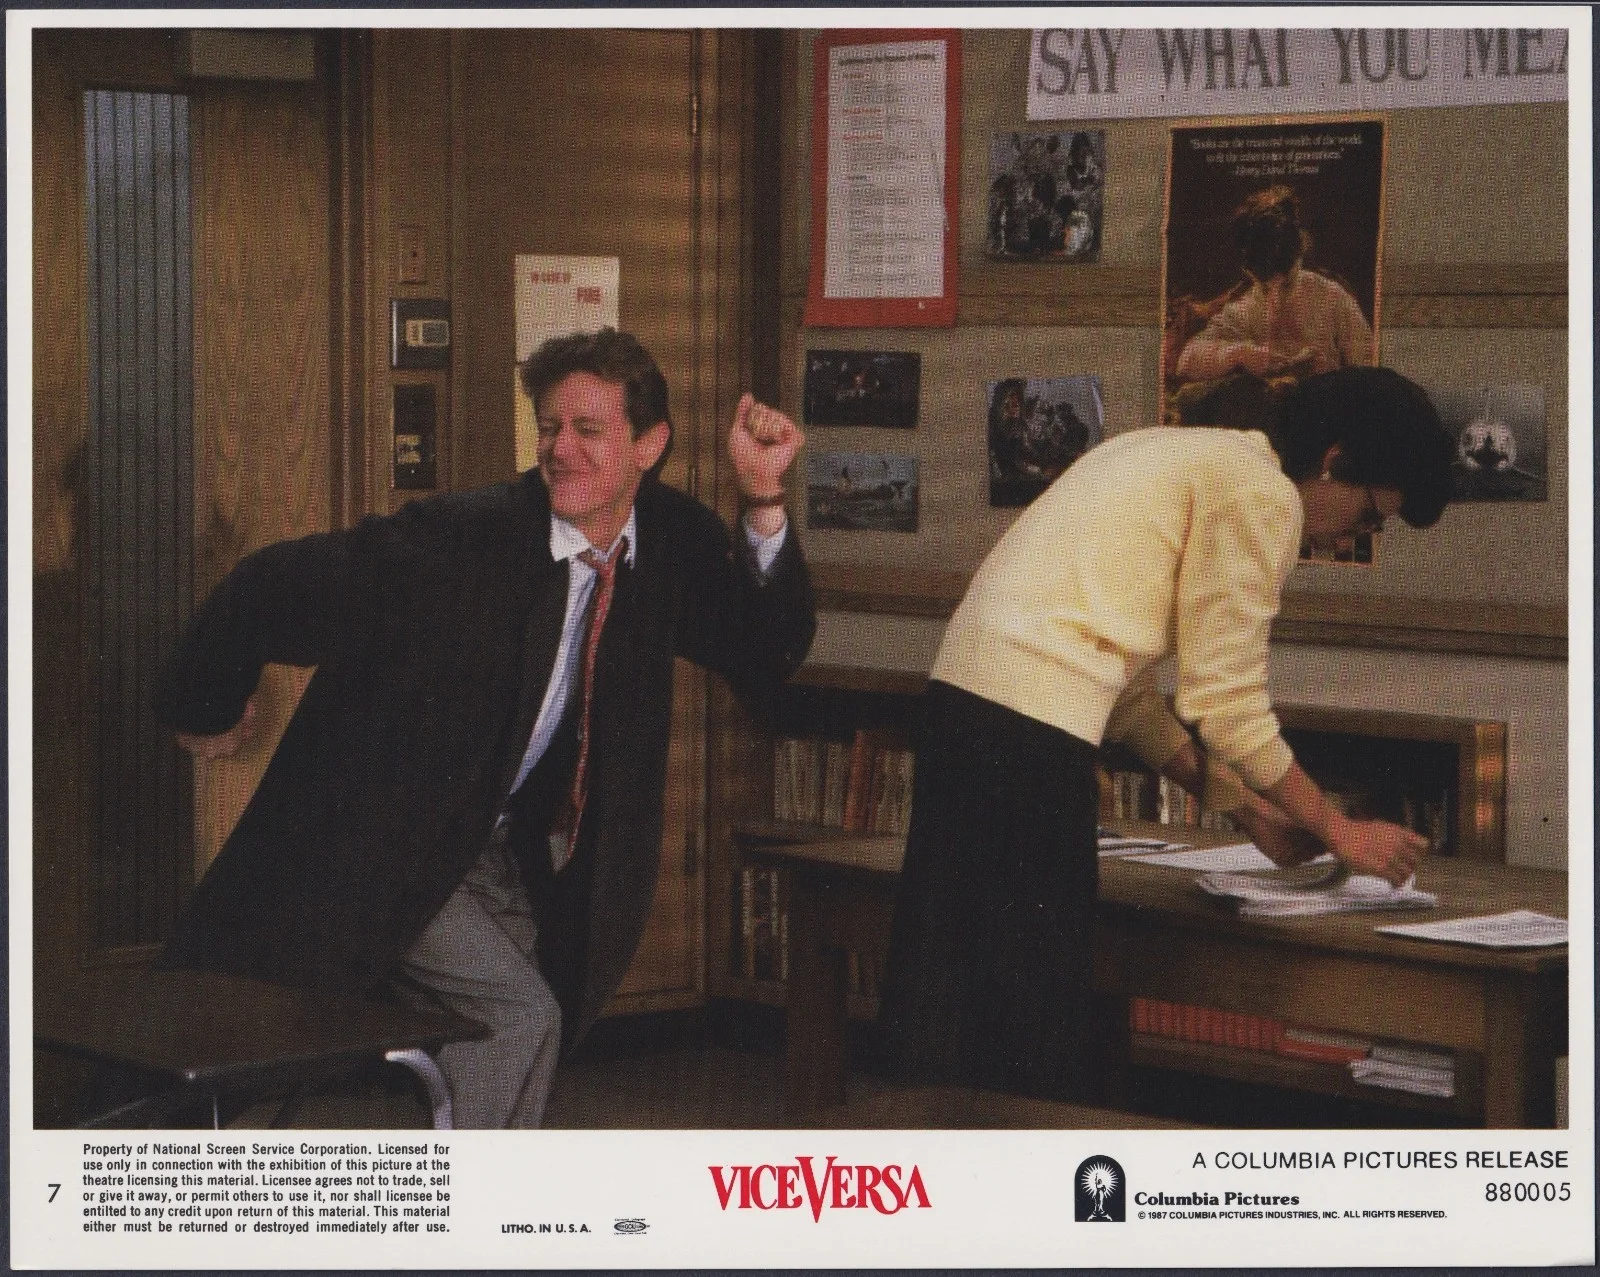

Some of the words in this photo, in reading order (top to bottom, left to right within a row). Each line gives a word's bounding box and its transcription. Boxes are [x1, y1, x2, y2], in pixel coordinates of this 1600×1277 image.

[1037, 28, 1124, 95] SAY
[1333, 28, 1430, 84] YOU
[1463, 28, 1569, 79] ME
[84, 1144, 132, 1157] Property
[137, 1144, 148, 1154] of
[153, 1143, 200, 1154] National
[207, 1143, 245, 1154] Screen
[252, 1143, 294, 1155] Service
[300, 1143, 371, 1156] Corporation.
[378, 1143, 427, 1154] Licensed
[434, 1144, 450, 1154] for
[84, 1162, 102, 1170] use
[107, 1159, 131, 1172] only
[137, 1159, 146, 1170] in
[152, 1159, 213, 1170] connection
[218, 1159, 242, 1170] with
[247, 1159, 265, 1170] the
[270, 1159, 325, 1170] exhibition
[331, 1159, 341, 1170] of
[346, 1159, 367, 1170] this
[373, 1159, 412, 1172] picture
[416, 1160, 427, 1170] at
[431, 1159, 450, 1170] the
[1193, 1152, 1206, 1168] A
[1215, 1152, 1335, 1169] COLUMBIA
[1344, 1151, 1457, 1169] PICTURES
[1466, 1151, 1568, 1168] RELEASE
[83, 1174, 123, 1185] theatre
[128, 1175, 178, 1188] licensing
[181, 1175, 203, 1185] this
[208, 1175, 258, 1186] material.
[262, 1175, 311, 1186] Licensee
[315, 1177, 352, 1188] agrees
[357, 1175, 374, 1185] not
[378, 1175, 389, 1185] to
[393, 1175, 426, 1187] trade,
[430, 1175, 449, 1185] sell
[48, 1184, 61, 1203] 7
[83, 1193, 95, 1201] or
[99, 1190, 122, 1203] give
[127, 1190, 134, 1201] it
[138, 1192, 171, 1203] away,
[176, 1193, 187, 1201] or
[192, 1190, 229, 1203] permit
[233, 1190, 268, 1201] others
[272, 1191, 283, 1201] to
[289, 1193, 308, 1201] use
[314, 1190, 325, 1203] it,
[331, 1193, 348, 1201] nor
[354, 1190, 381, 1201] shall
[387, 1190, 432, 1201] licensee
[437, 1190, 450, 1201] be
[1134, 1192, 1219, 1205] Columbia
[1225, 1192, 1299, 1205] Pictures
[1486, 1183, 1570, 1202] 880005
[83, 1205, 126, 1216] entilted
[130, 1206, 141, 1216] to
[145, 1208, 164, 1218] any
[168, 1206, 201, 1216] credit
[205, 1208, 232, 1219] upon
[238, 1206, 272, 1217] return
[277, 1206, 288, 1217] of
[292, 1206, 314, 1217] this
[319, 1206, 369, 1217] material.
[374, 1206, 398, 1216] This
[404, 1206, 449, 1216] material
[1219, 1211, 1263, 1219] PICTURES
[1265, 1211, 1320, 1219] INDUSTRIES,
[1323, 1211, 1340, 1219] INC.
[83, 1221, 116, 1232] either
[124, 1221, 152, 1232] must
[159, 1221, 172, 1232] be
[179, 1221, 227, 1232] returned
[235, 1224, 246, 1232] or
[254, 1221, 309, 1234] destroyed
[317, 1221, 387, 1234] immediately
[393, 1221, 419, 1232] after
[427, 1224, 449, 1232] use.
